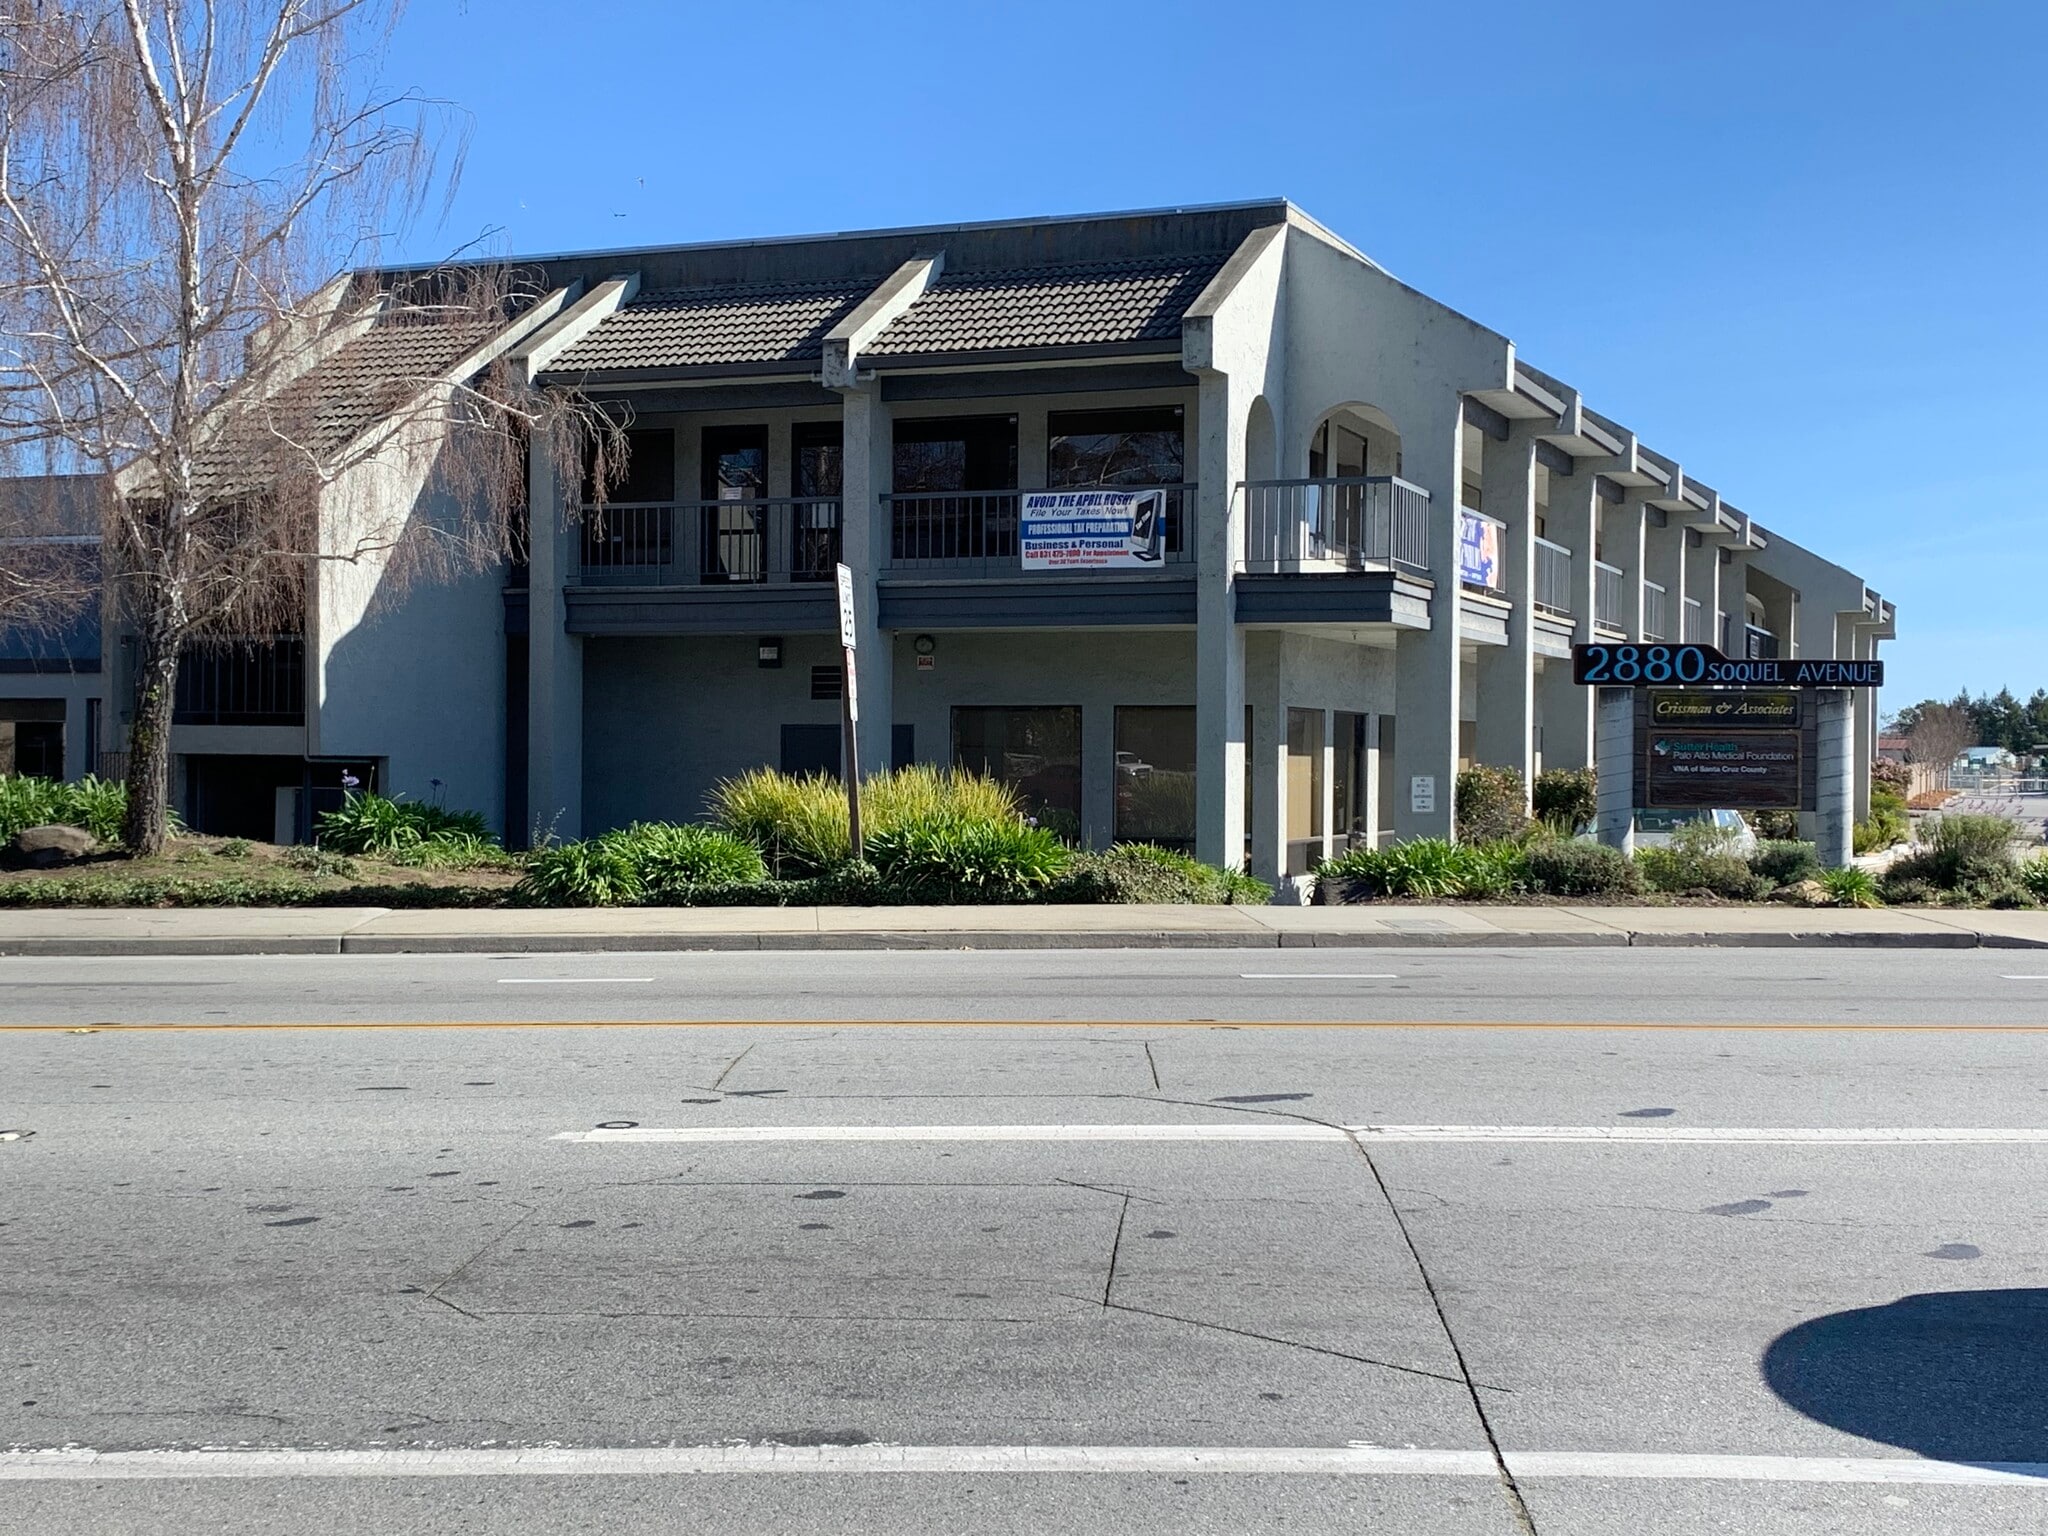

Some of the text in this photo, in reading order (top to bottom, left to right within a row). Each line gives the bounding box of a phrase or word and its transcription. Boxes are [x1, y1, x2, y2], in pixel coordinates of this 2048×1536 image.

[1027, 493, 1135, 508] AVOID THE APRIL RUSH!
[1030, 506, 1128, 517] File Your Taxes Now!
[1028, 521, 1129, 536] PROFESSIONAL TAX PREPARATION
[1025, 539, 1123, 550] Business & Personal
[1025, 551, 1039, 559] Call
[1584, 646, 1879, 682] 2880 SOQUEL AVENUE
[1656, 701, 1794, 715] Crissman & Associates
[1673, 741, 1738, 751] Sutter Health
[1673, 751, 1794, 761] Palo Alto Medical Foundation
[1741, 766, 1768, 774] County
